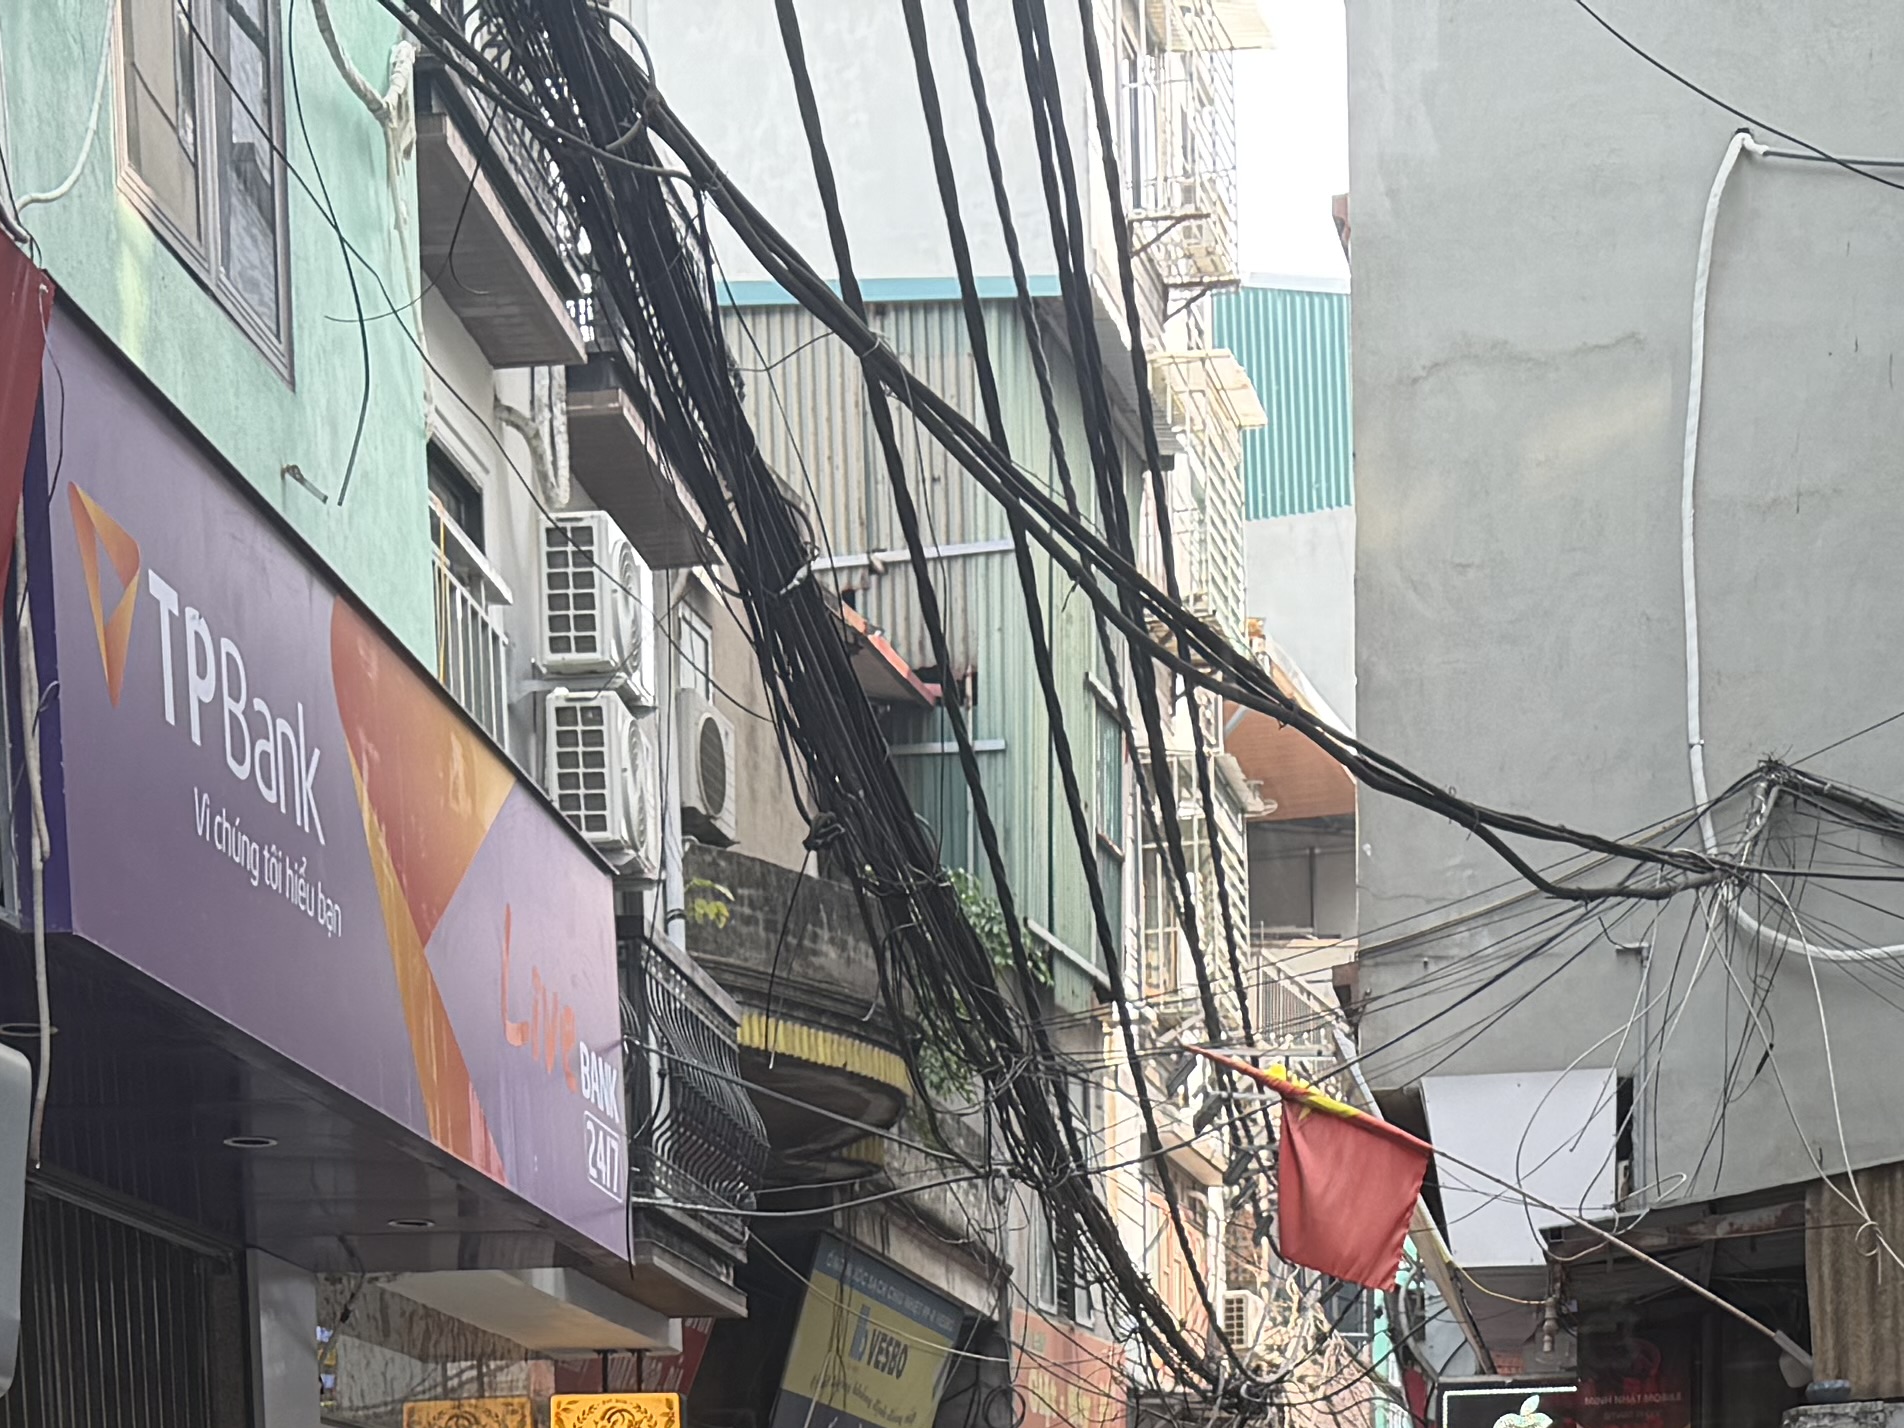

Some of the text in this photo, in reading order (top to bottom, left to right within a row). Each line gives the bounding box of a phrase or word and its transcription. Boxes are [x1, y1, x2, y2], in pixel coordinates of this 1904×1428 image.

[148, 568, 326, 846] TPBank
[194, 787, 342, 940] Vì chúng tôi hiểu bạn
[580, 1039, 620, 1124] BANK
[587, 1123, 621, 1194] 24/7
[867, 1329, 908, 1380] VESBO
